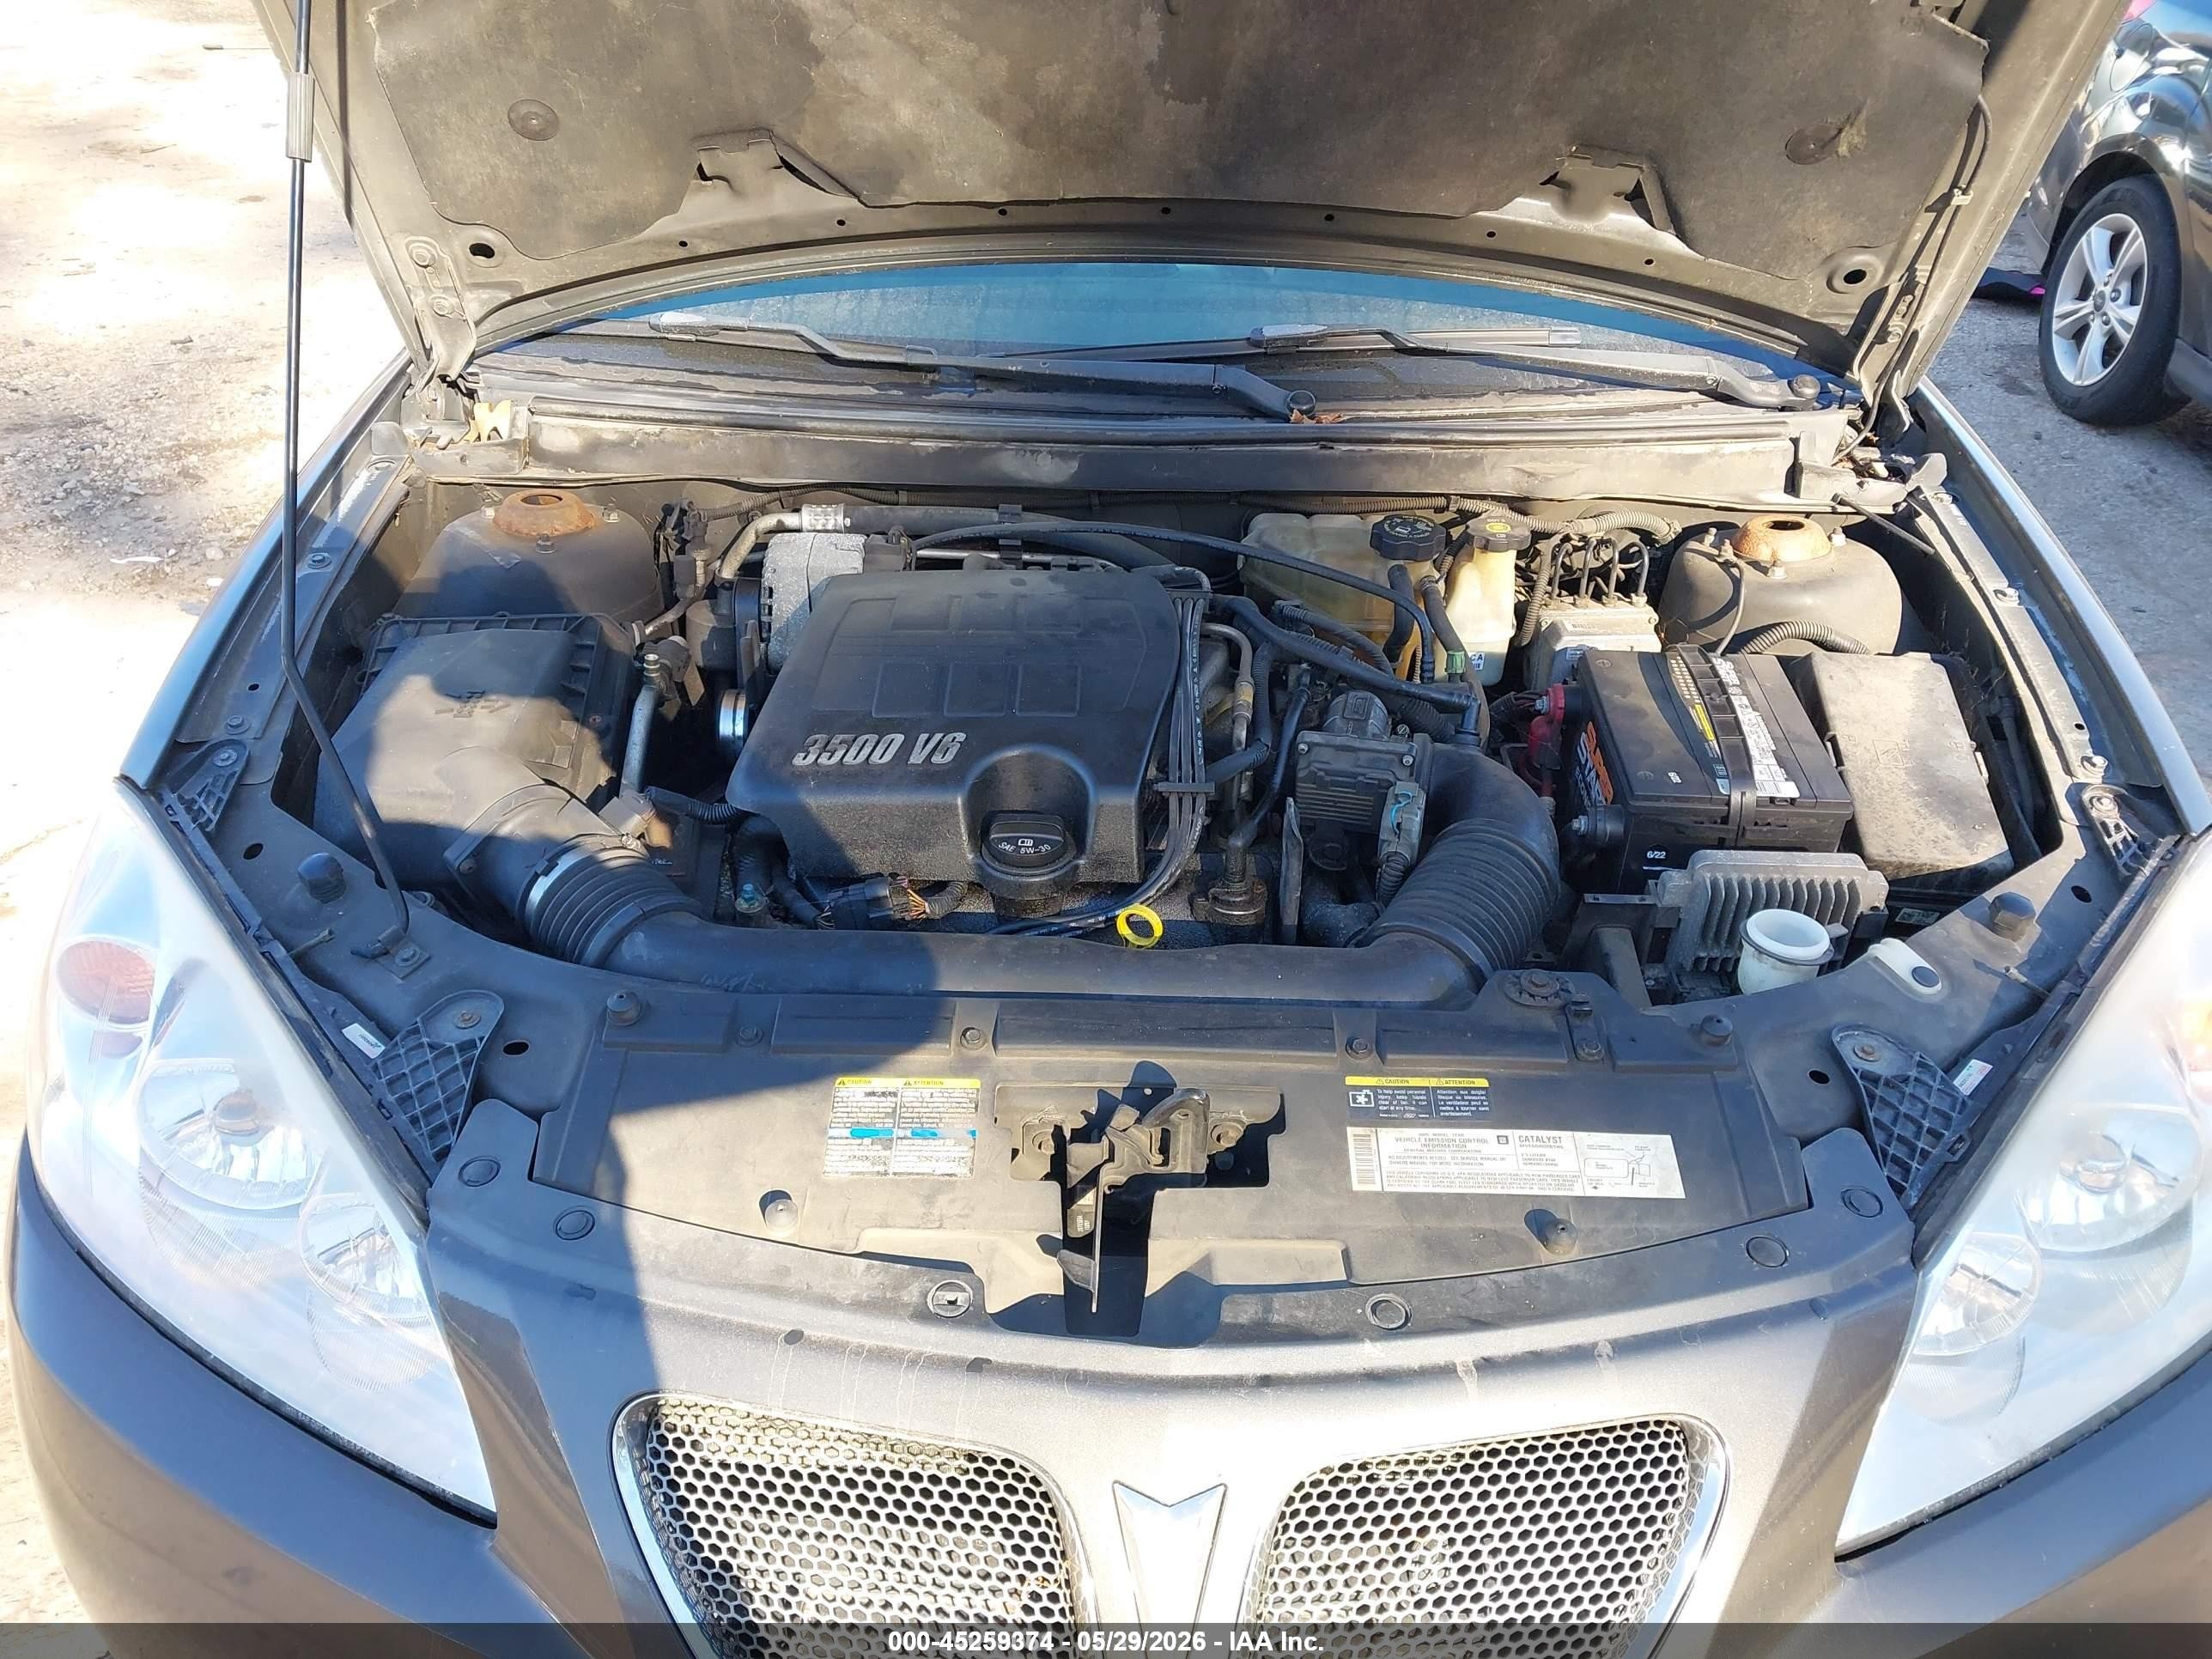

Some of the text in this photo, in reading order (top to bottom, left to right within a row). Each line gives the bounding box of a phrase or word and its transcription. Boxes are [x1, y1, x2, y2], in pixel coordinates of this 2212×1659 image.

[792, 732, 967, 766] 3500 V6
[999, 842, 1051, 854] SAE 5W-30
[1518, 1135, 1563, 1144] CATALYST
